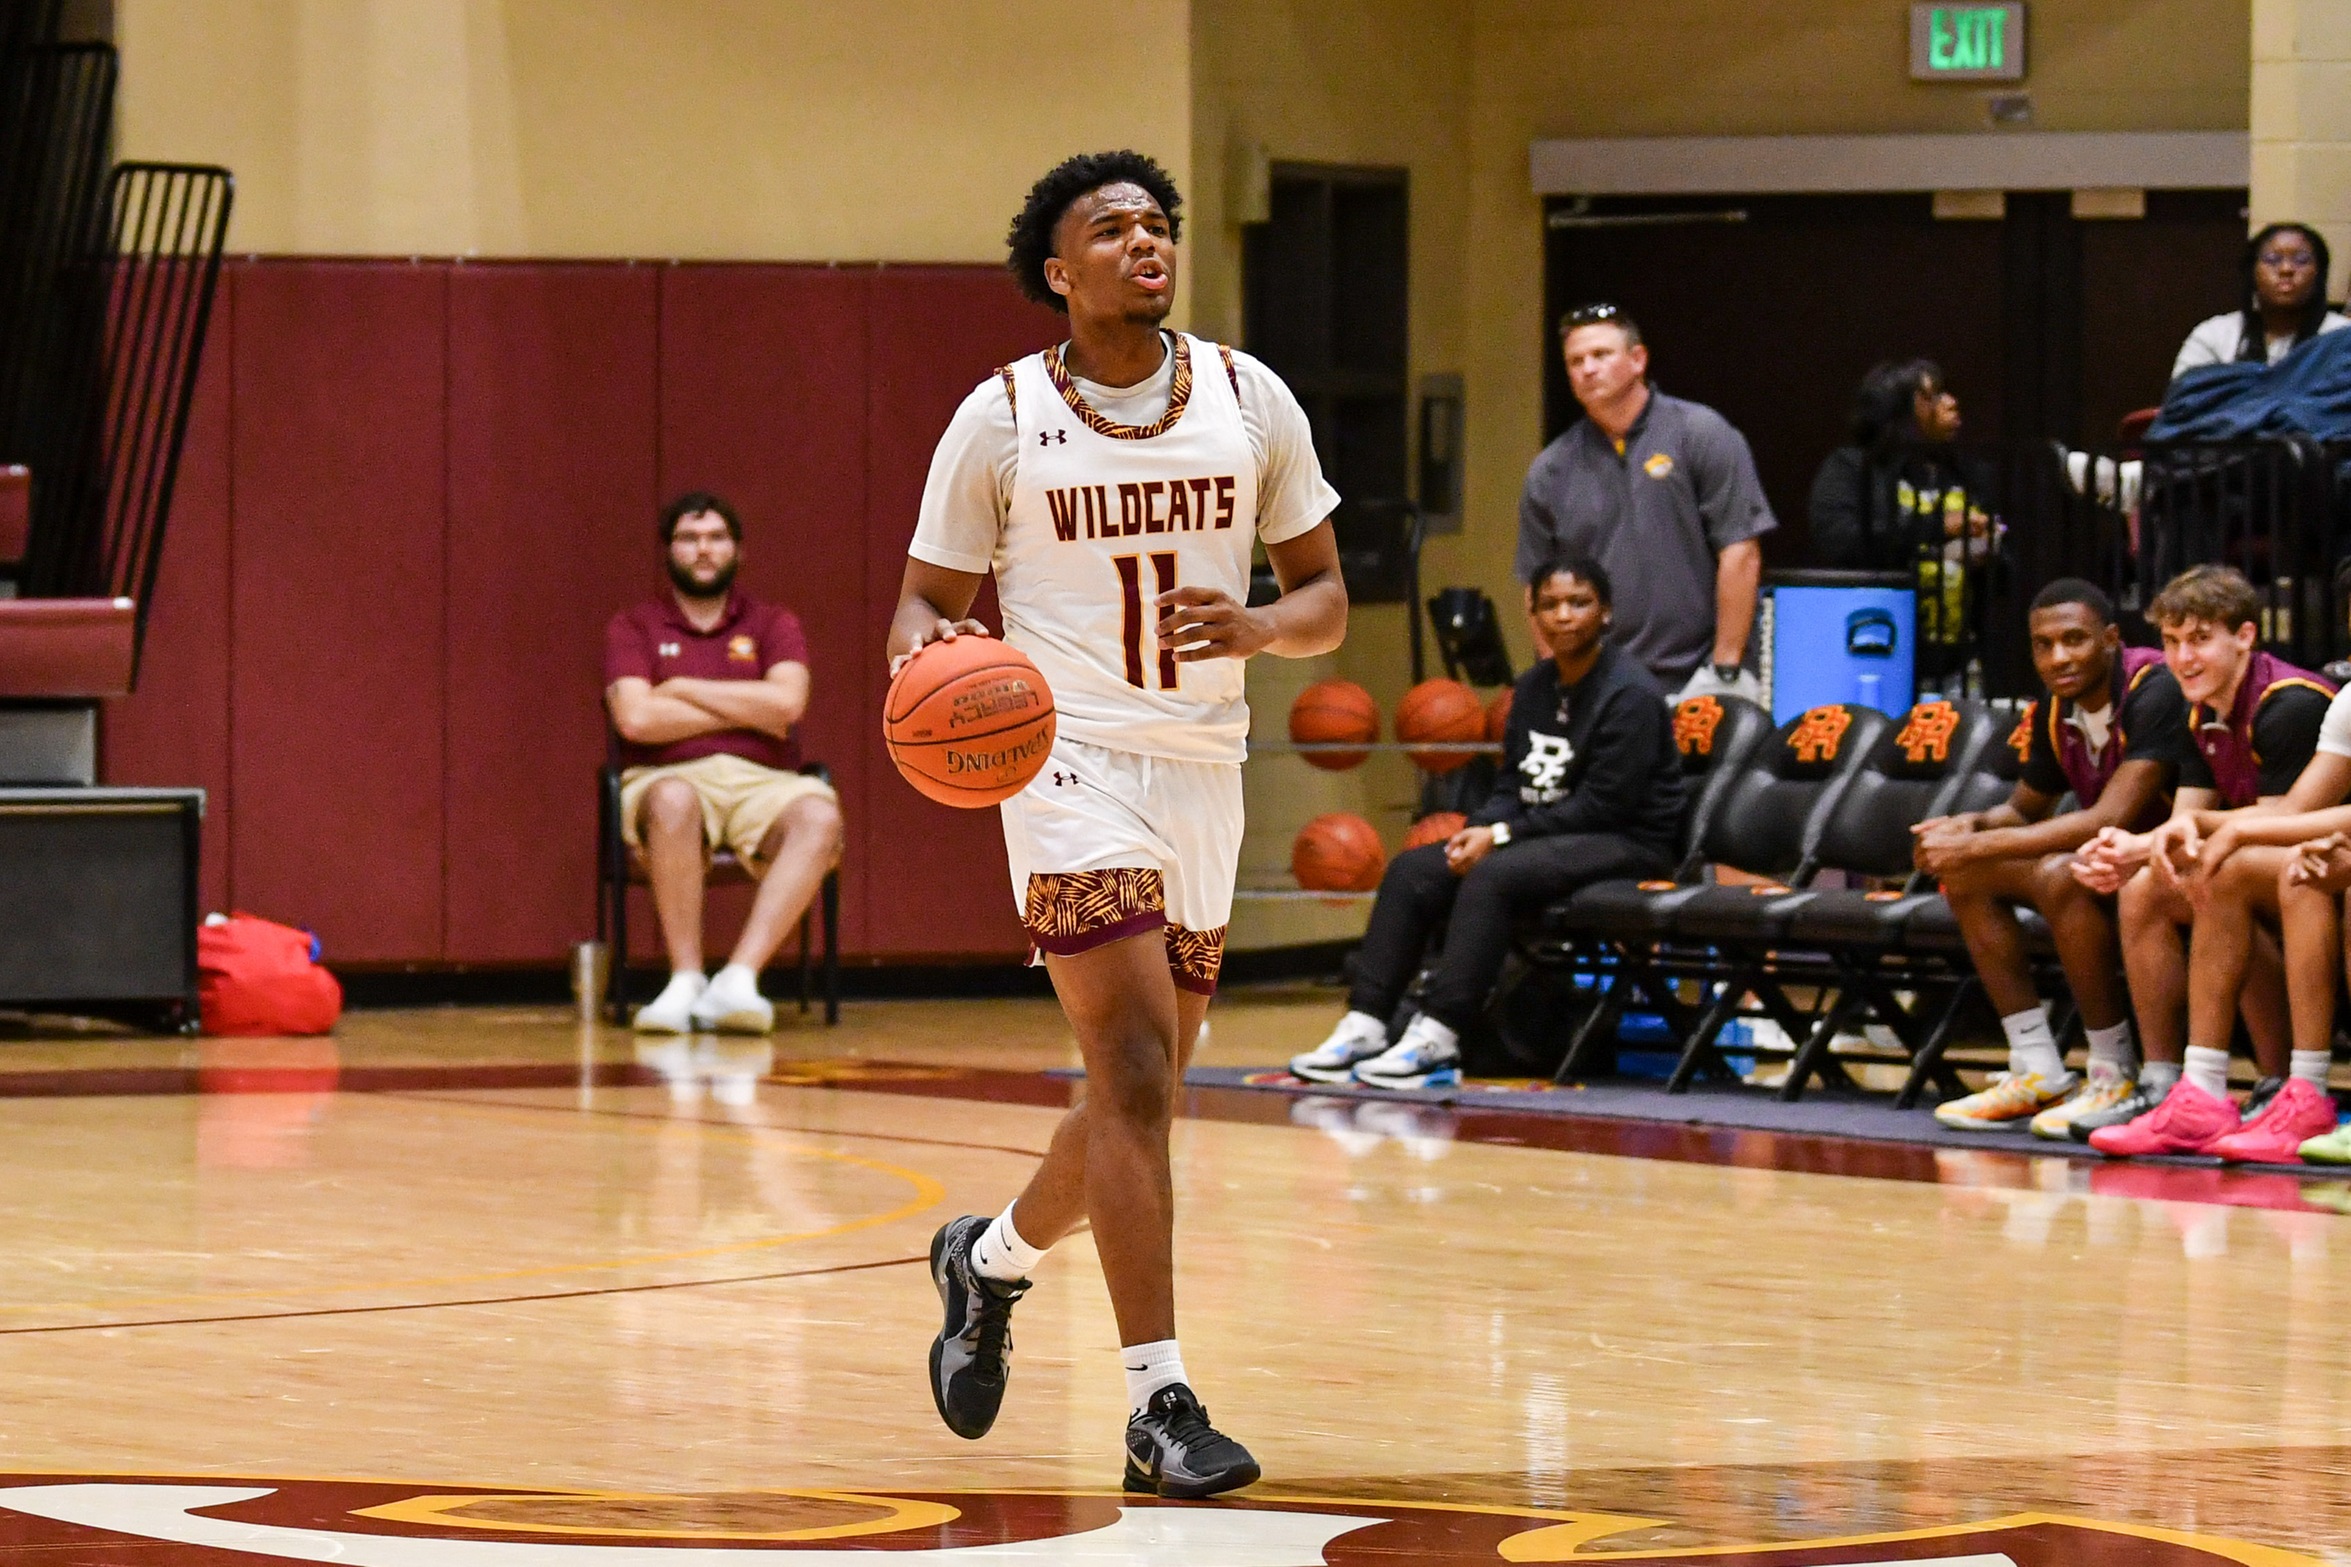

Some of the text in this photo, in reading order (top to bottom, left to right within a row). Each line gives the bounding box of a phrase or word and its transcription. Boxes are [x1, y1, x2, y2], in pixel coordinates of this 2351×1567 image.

[1929, 9, 2008, 70] EXIT
[1045, 475, 1236, 542] WILDCATS
[1109, 550, 1181, 691] 11
